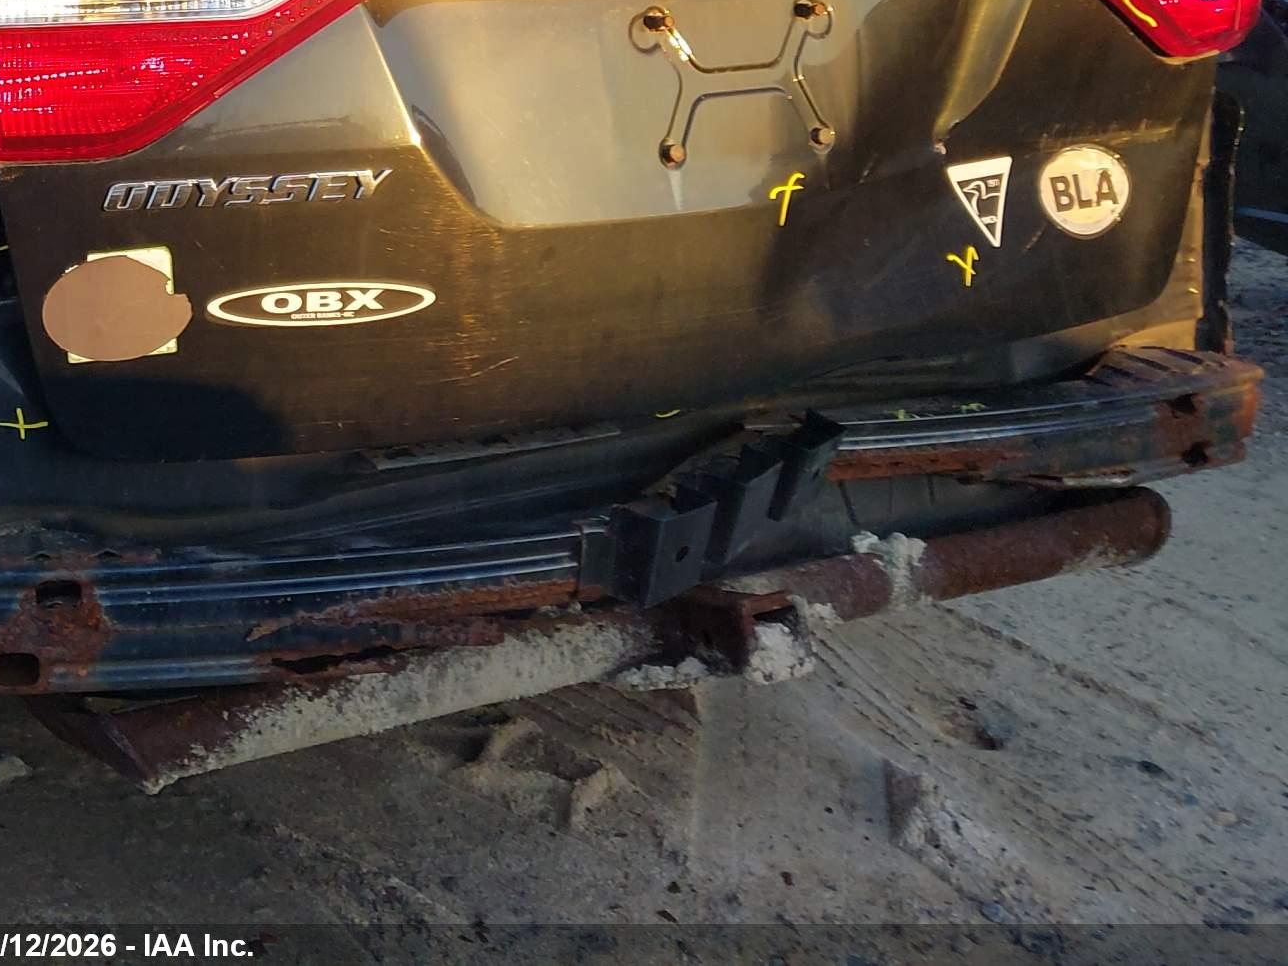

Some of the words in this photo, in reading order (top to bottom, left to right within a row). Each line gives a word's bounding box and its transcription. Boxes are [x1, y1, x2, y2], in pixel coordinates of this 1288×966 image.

[102, 169, 394, 213] ODYSSEY
[1049, 168, 1119, 213] BLA
[261, 289, 385, 314] OBX
